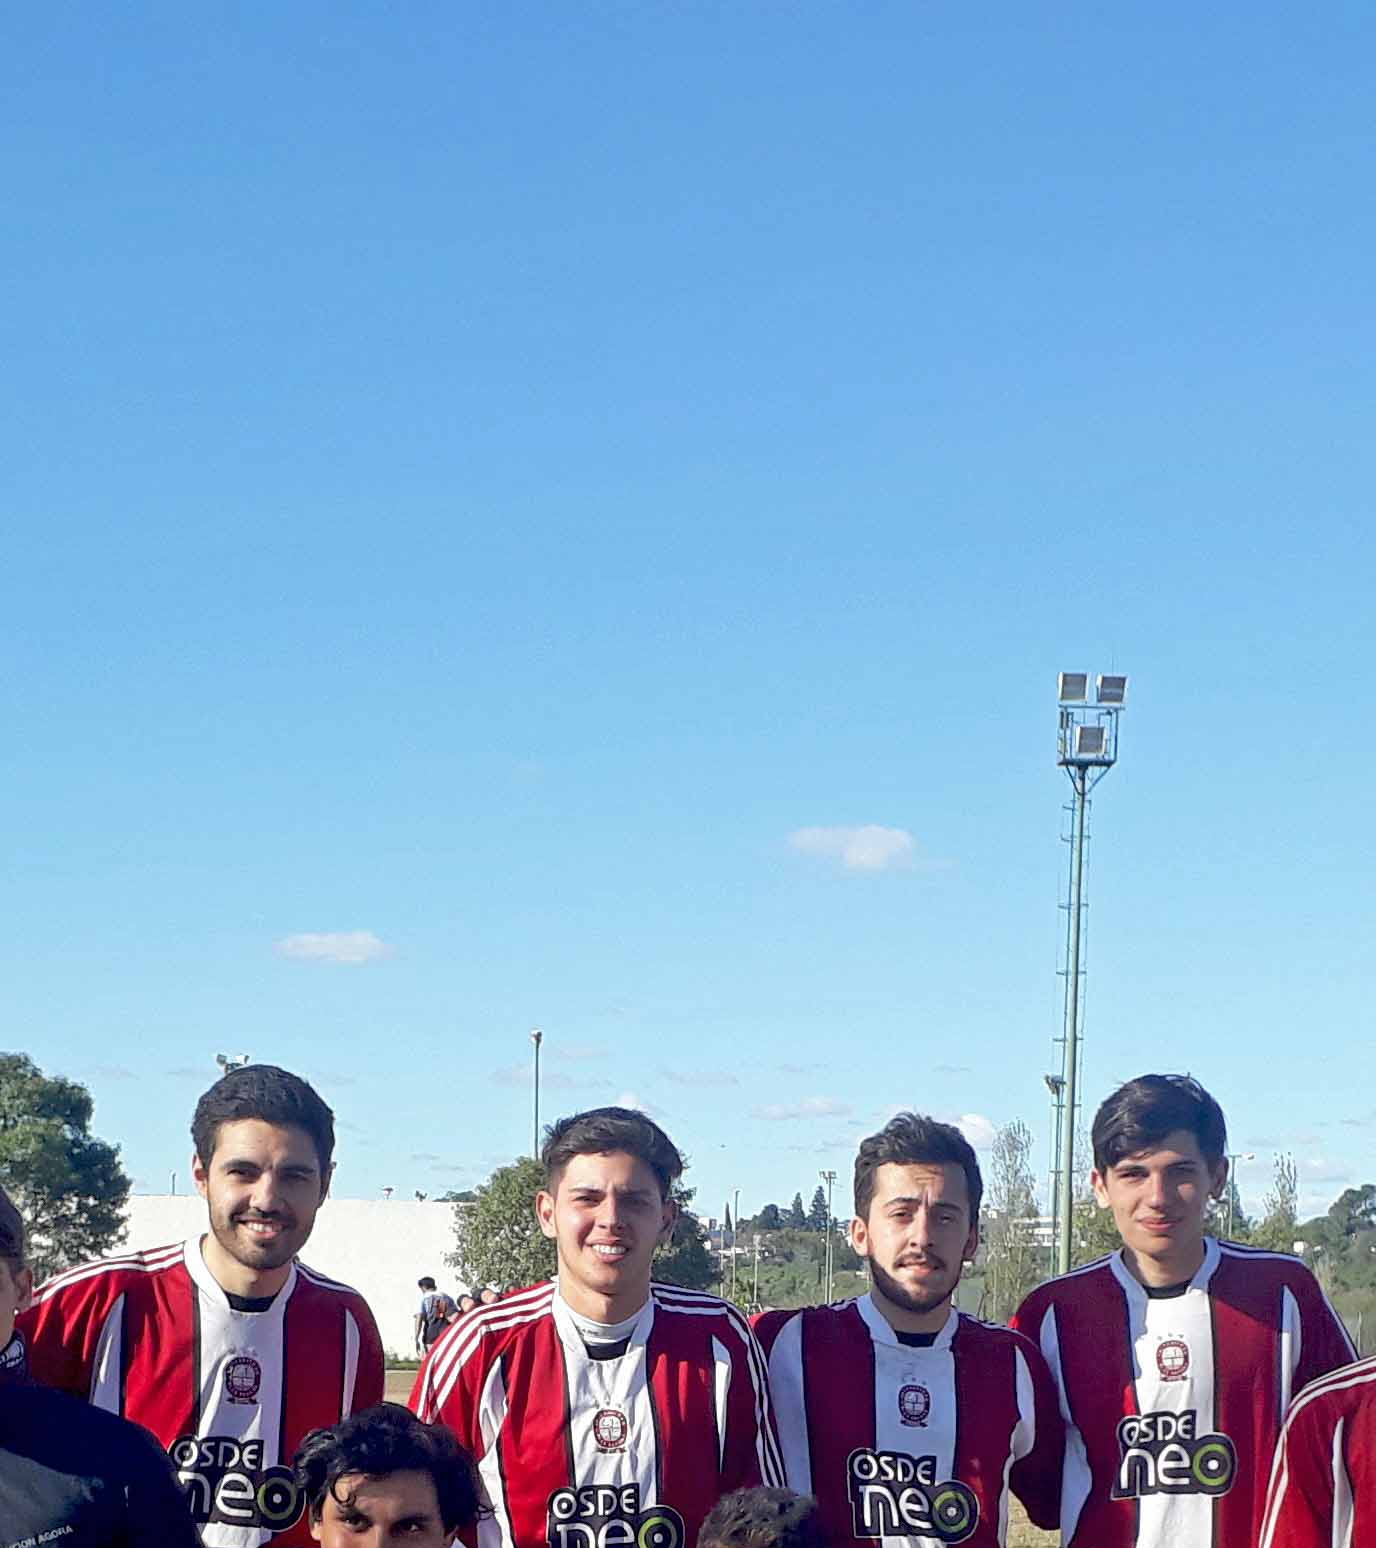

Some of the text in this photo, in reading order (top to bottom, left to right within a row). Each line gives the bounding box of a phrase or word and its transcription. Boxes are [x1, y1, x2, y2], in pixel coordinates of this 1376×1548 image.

[1122, 1414, 1192, 1446] OSDE
[173, 1440, 260, 1470] OSDE
[853, 1453, 932, 1486] OSDE
[1120, 1443, 1233, 1490] neo
[177, 1471, 298, 1521] neo
[552, 1488, 636, 1519] OSDE
[858, 1484, 970, 1533] neo
